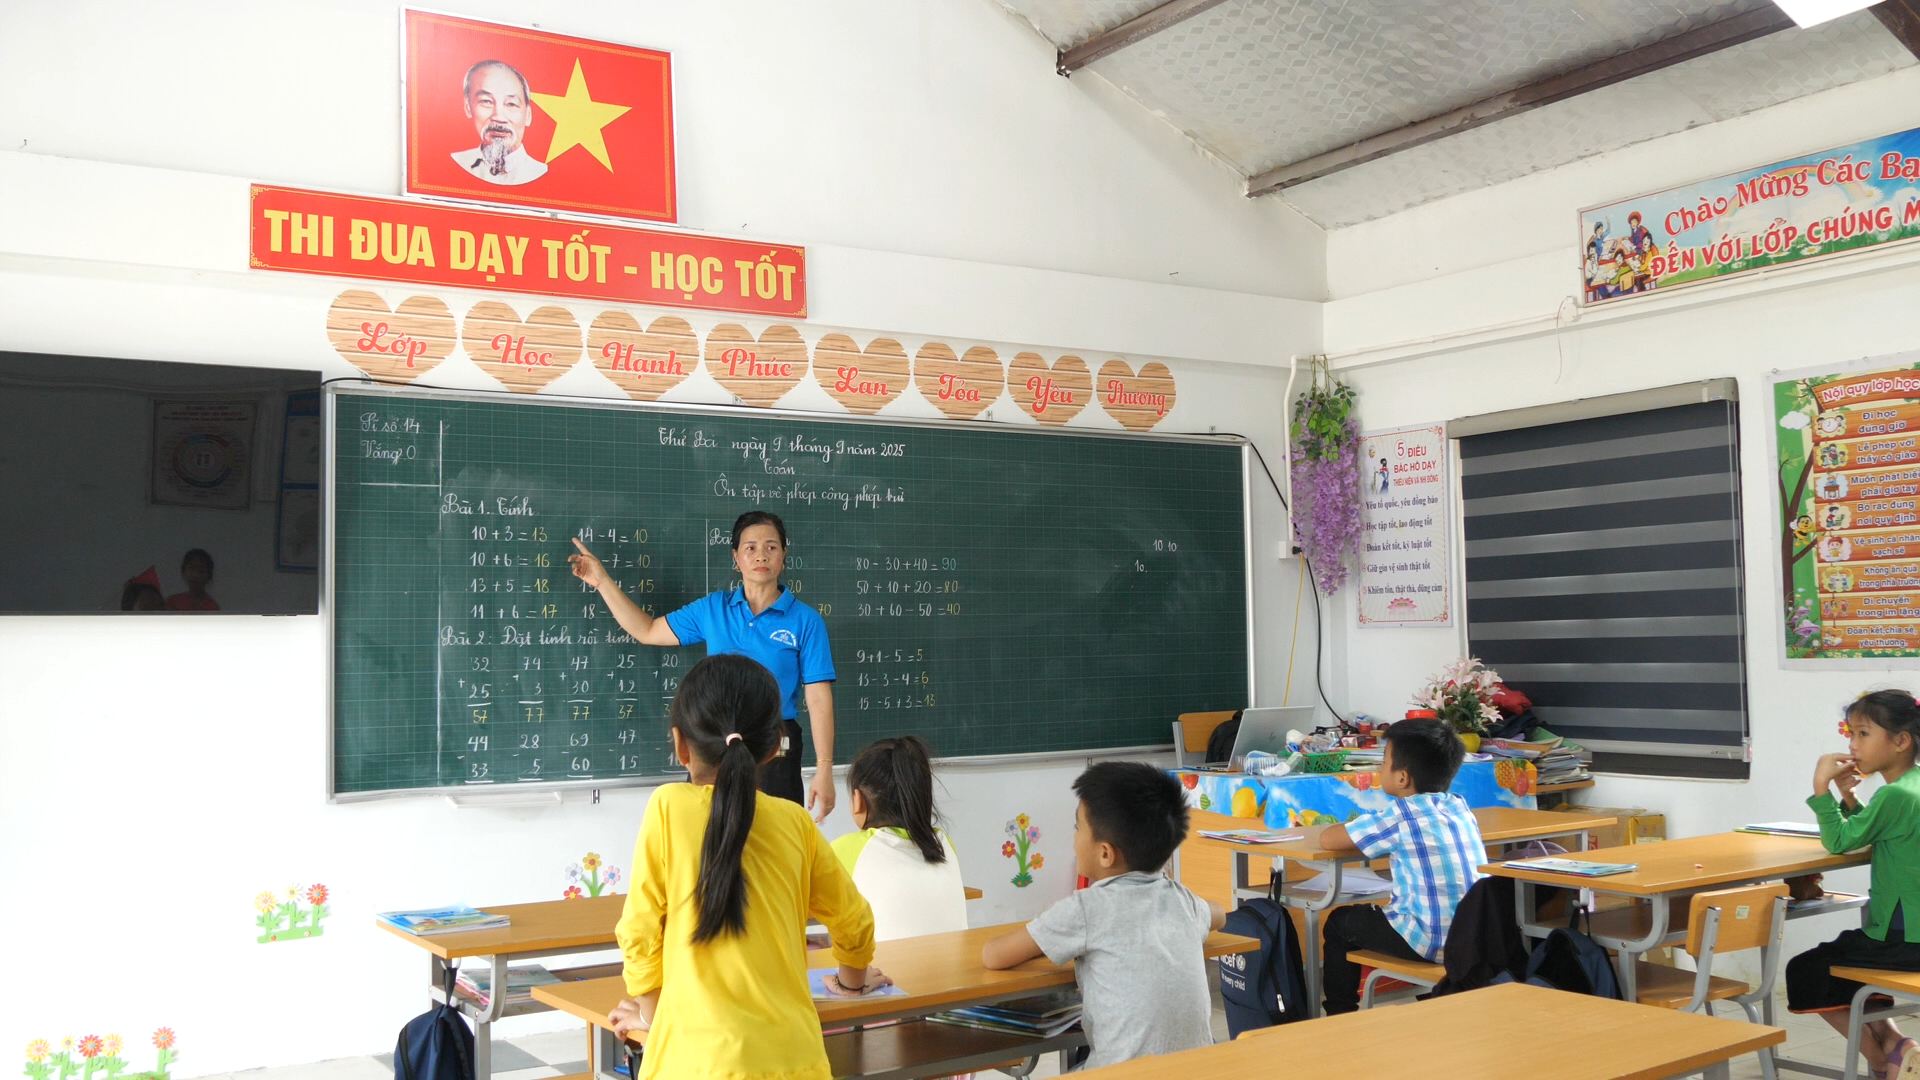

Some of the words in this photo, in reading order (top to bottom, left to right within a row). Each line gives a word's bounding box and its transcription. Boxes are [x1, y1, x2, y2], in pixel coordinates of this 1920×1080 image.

[1664, 194, 1729, 236] Chào
[1736, 168, 1809, 208] Mừng
[1816, 155, 1872, 186] Các
[1879, 152, 1920, 183] Bạ
[1650, 238, 1695, 278] ĐẾN
[1702, 233, 1743, 266] VỚI
[1752, 222, 1798, 257] LỚP
[1806, 207, 1894, 244] CHÚNG
[263, 209, 334, 257] THI
[350, 220, 435, 267] ĐUA
[450, 229, 529, 282] DẠY
[542, 229, 611, 283] TỐT
[651, 250, 723, 299] HỌC
[735, 248, 796, 301] TỐT
[357, 321, 427, 367] Lớp
[491, 333, 554, 373] Học
[602, 342, 684, 380] Hạnh
[720, 348, 793, 378] Phúc
[835, 366, 888, 396] Lan
[938, 373, 981, 402] Tỏa
[1026, 376, 1073, 414] Yêu
[1107, 378, 1167, 416] Thương
[1823, 386, 1844, 400] Nội
[1847, 384, 1869, 396] quy
[1872, 379, 1892, 391] lớp
[1895, 378, 1920, 391] học
[1863, 412, 1874, 420] Đi
[1877, 410, 1897, 418] học
[403, 417, 420, 433] 14
[360, 440, 402, 464] Vắng
[658, 427, 686, 446] Thứ
[732, 436, 766, 460] ngày
[773, 437, 781, 451] 9
[788, 434, 834, 463] tháng
[846, 442, 877, 456] năm
[880, 442, 905, 457] 2025
[1397, 442, 1405, 456] 5
[763, 457, 796, 475] Toán
[1903, 469, 1920, 479] biể
[714, 472, 735, 497] Ôn
[742, 484, 765, 505] tập
[786, 482, 817, 505] phép
[855, 484, 882, 509] phép
[441, 493, 473, 514] Bài
[497, 495, 534, 516] Tính
[471, 526, 487, 541] 10
[505, 525, 514, 541] 3
[532, 527, 548, 542] 13
[1153, 539, 1163, 551] 10
[1168, 541, 1177, 552] 10
[856, 557, 869, 571] 80
[885, 557, 900, 571] 30
[913, 558, 928, 571] 40
[942, 557, 957, 571] 90
[1885, 607, 1897, 616] im
[441, 625, 470, 645] Bài
[500, 625, 532, 648] Đặt
[538, 625, 572, 645] tính
[471, 657, 489, 672] 32
[523, 657, 541, 671] 74
[571, 657, 589, 670] 47
[617, 654, 636, 669] 25
[661, 653, 678, 668] 20
[469, 684, 492, 699] 25
[535, 682, 542, 696] 3
[572, 680, 589, 695] 30
[618, 679, 636, 693] 12
[662, 677, 678, 691] 15
[473, 710, 488, 724] 57
[525, 707, 545, 723] 77
[573, 705, 590, 721] 77
[618, 704, 634, 719] 37
[468, 736, 488, 752] 44
[520, 734, 539, 749] 28
[570, 733, 589, 747] 69
[618, 730, 637, 745] 47
[471, 762, 488, 778] 33
[532, 758, 541, 775] 5
[572, 757, 590, 771] 60
[620, 755, 638, 770] 15
